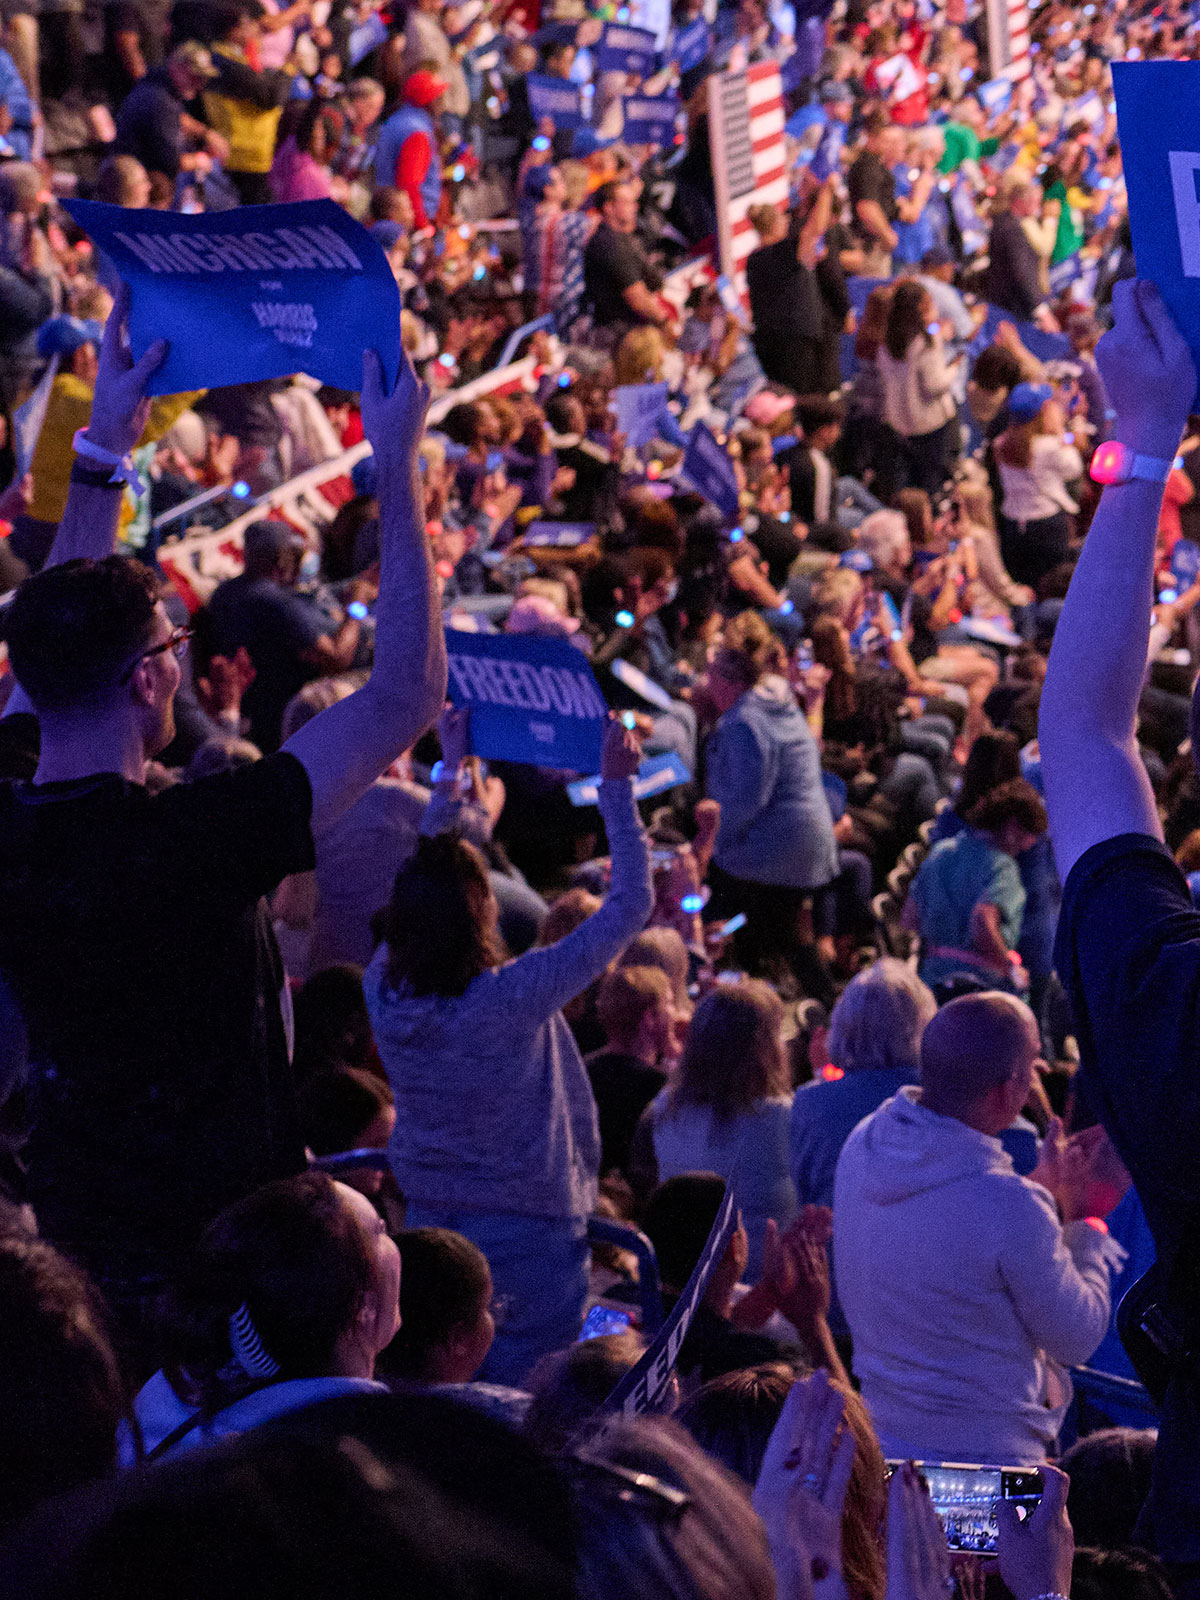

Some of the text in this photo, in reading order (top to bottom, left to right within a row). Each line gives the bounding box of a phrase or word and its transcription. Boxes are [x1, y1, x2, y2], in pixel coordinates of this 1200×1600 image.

[113, 224, 363, 273] MICHIGAN
[251, 302, 318, 332] HARRIS
[448, 653, 605, 720] FREEDOM
